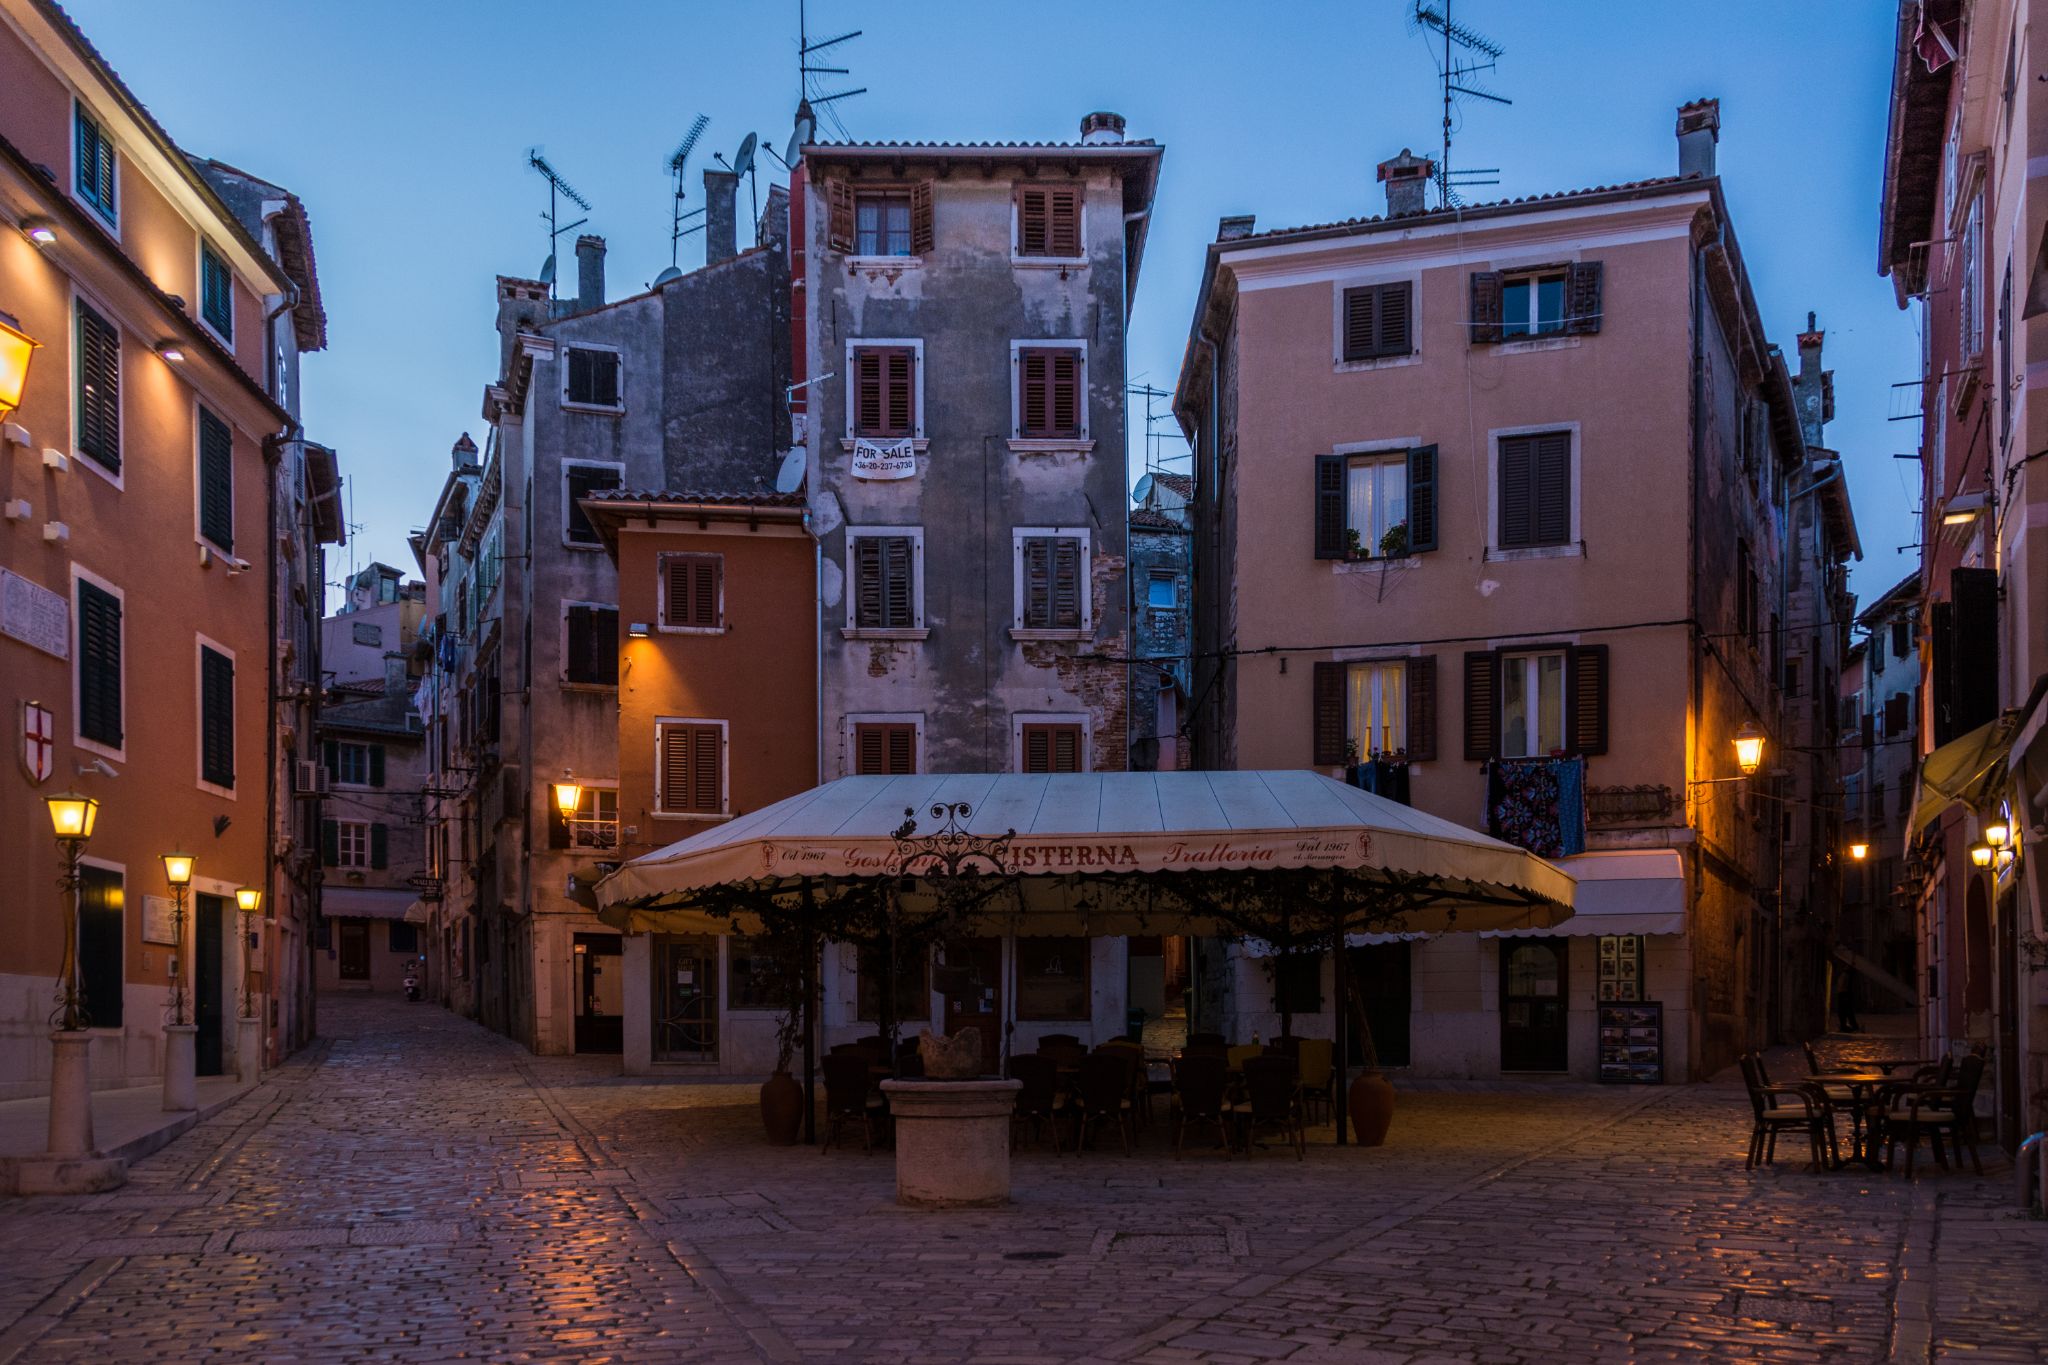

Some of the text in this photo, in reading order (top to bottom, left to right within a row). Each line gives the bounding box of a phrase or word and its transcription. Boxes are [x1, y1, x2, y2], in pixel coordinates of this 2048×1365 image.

[856, 446, 912, 459] FOR SALE
[1323, 842, 1350, 852] 1967
[798, 851, 826, 860] 1967
[1162, 842, 1275, 864] Trattoria
